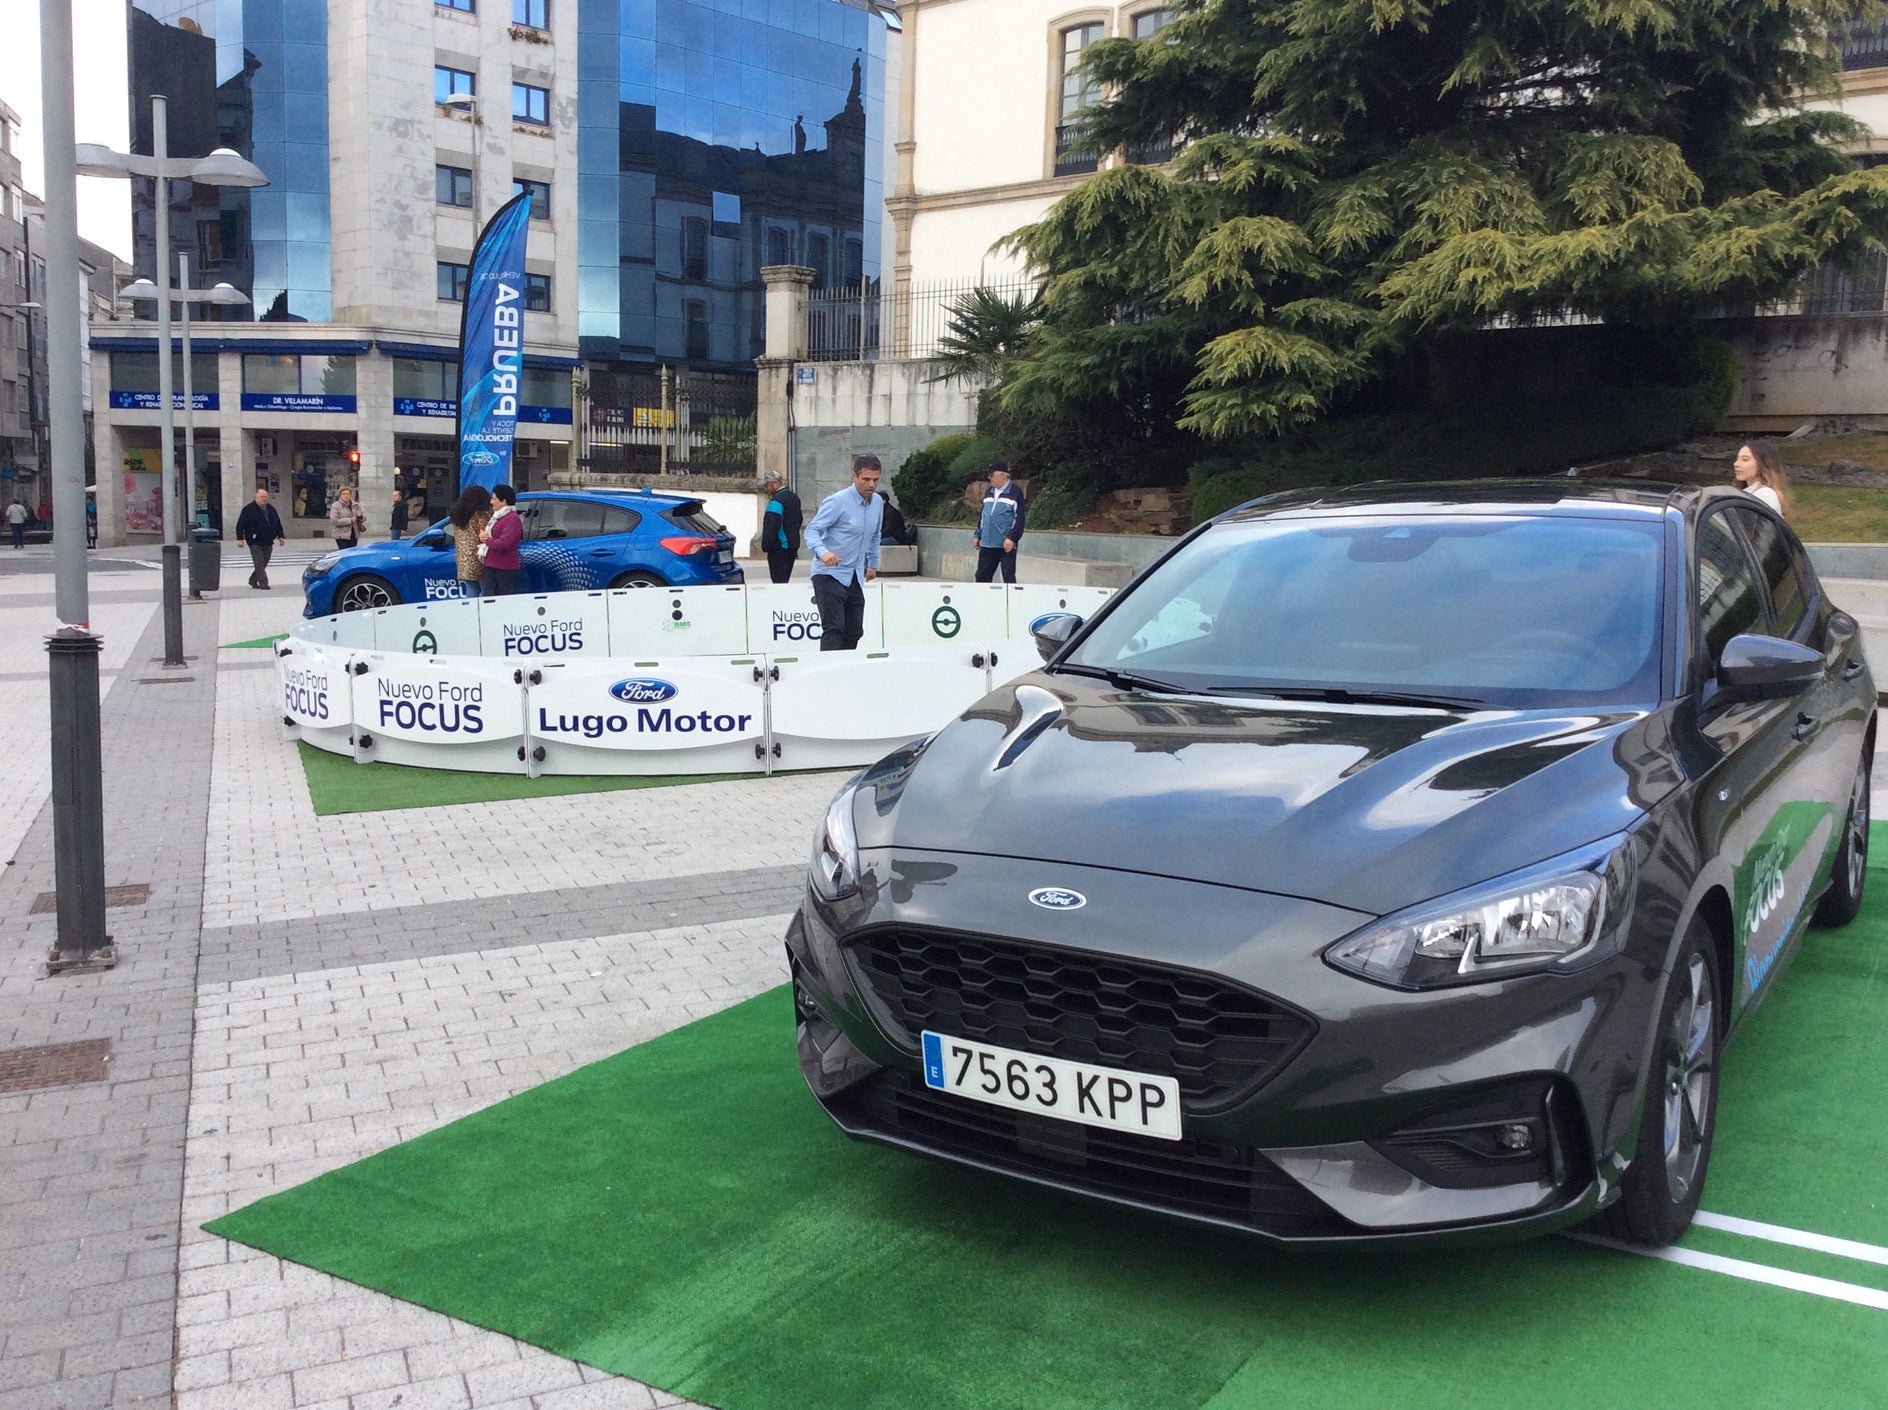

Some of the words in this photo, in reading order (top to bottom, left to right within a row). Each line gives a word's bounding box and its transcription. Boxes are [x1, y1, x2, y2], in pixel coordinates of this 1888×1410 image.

[284, 396, 324, 405] VILLAMARÍN
[424, 577, 457, 587] Nuevo
[425, 586, 467, 599] FOCU
[503, 622, 547, 637] Nuevo
[550, 618, 583, 633] Ford
[772, 610, 820, 622] Nuevo
[504, 632, 583, 657] FOCUS
[284, 664, 305, 686] Nuevo
[305, 669, 328, 691] Ford
[377, 677, 434, 700] Nuevo
[438, 681, 483, 703] Ford
[285, 683, 329, 720] FOCUS
[619, 680, 668, 701] Ford
[379, 699, 484, 734] FOCUS
[539, 707, 628, 739] Lugo
[637, 708, 752, 733] Motor
[931, 1066, 939, 1078] E
[951, 1045, 1058, 1107] 7563
[1076, 1071, 1166, 1126] KPP
